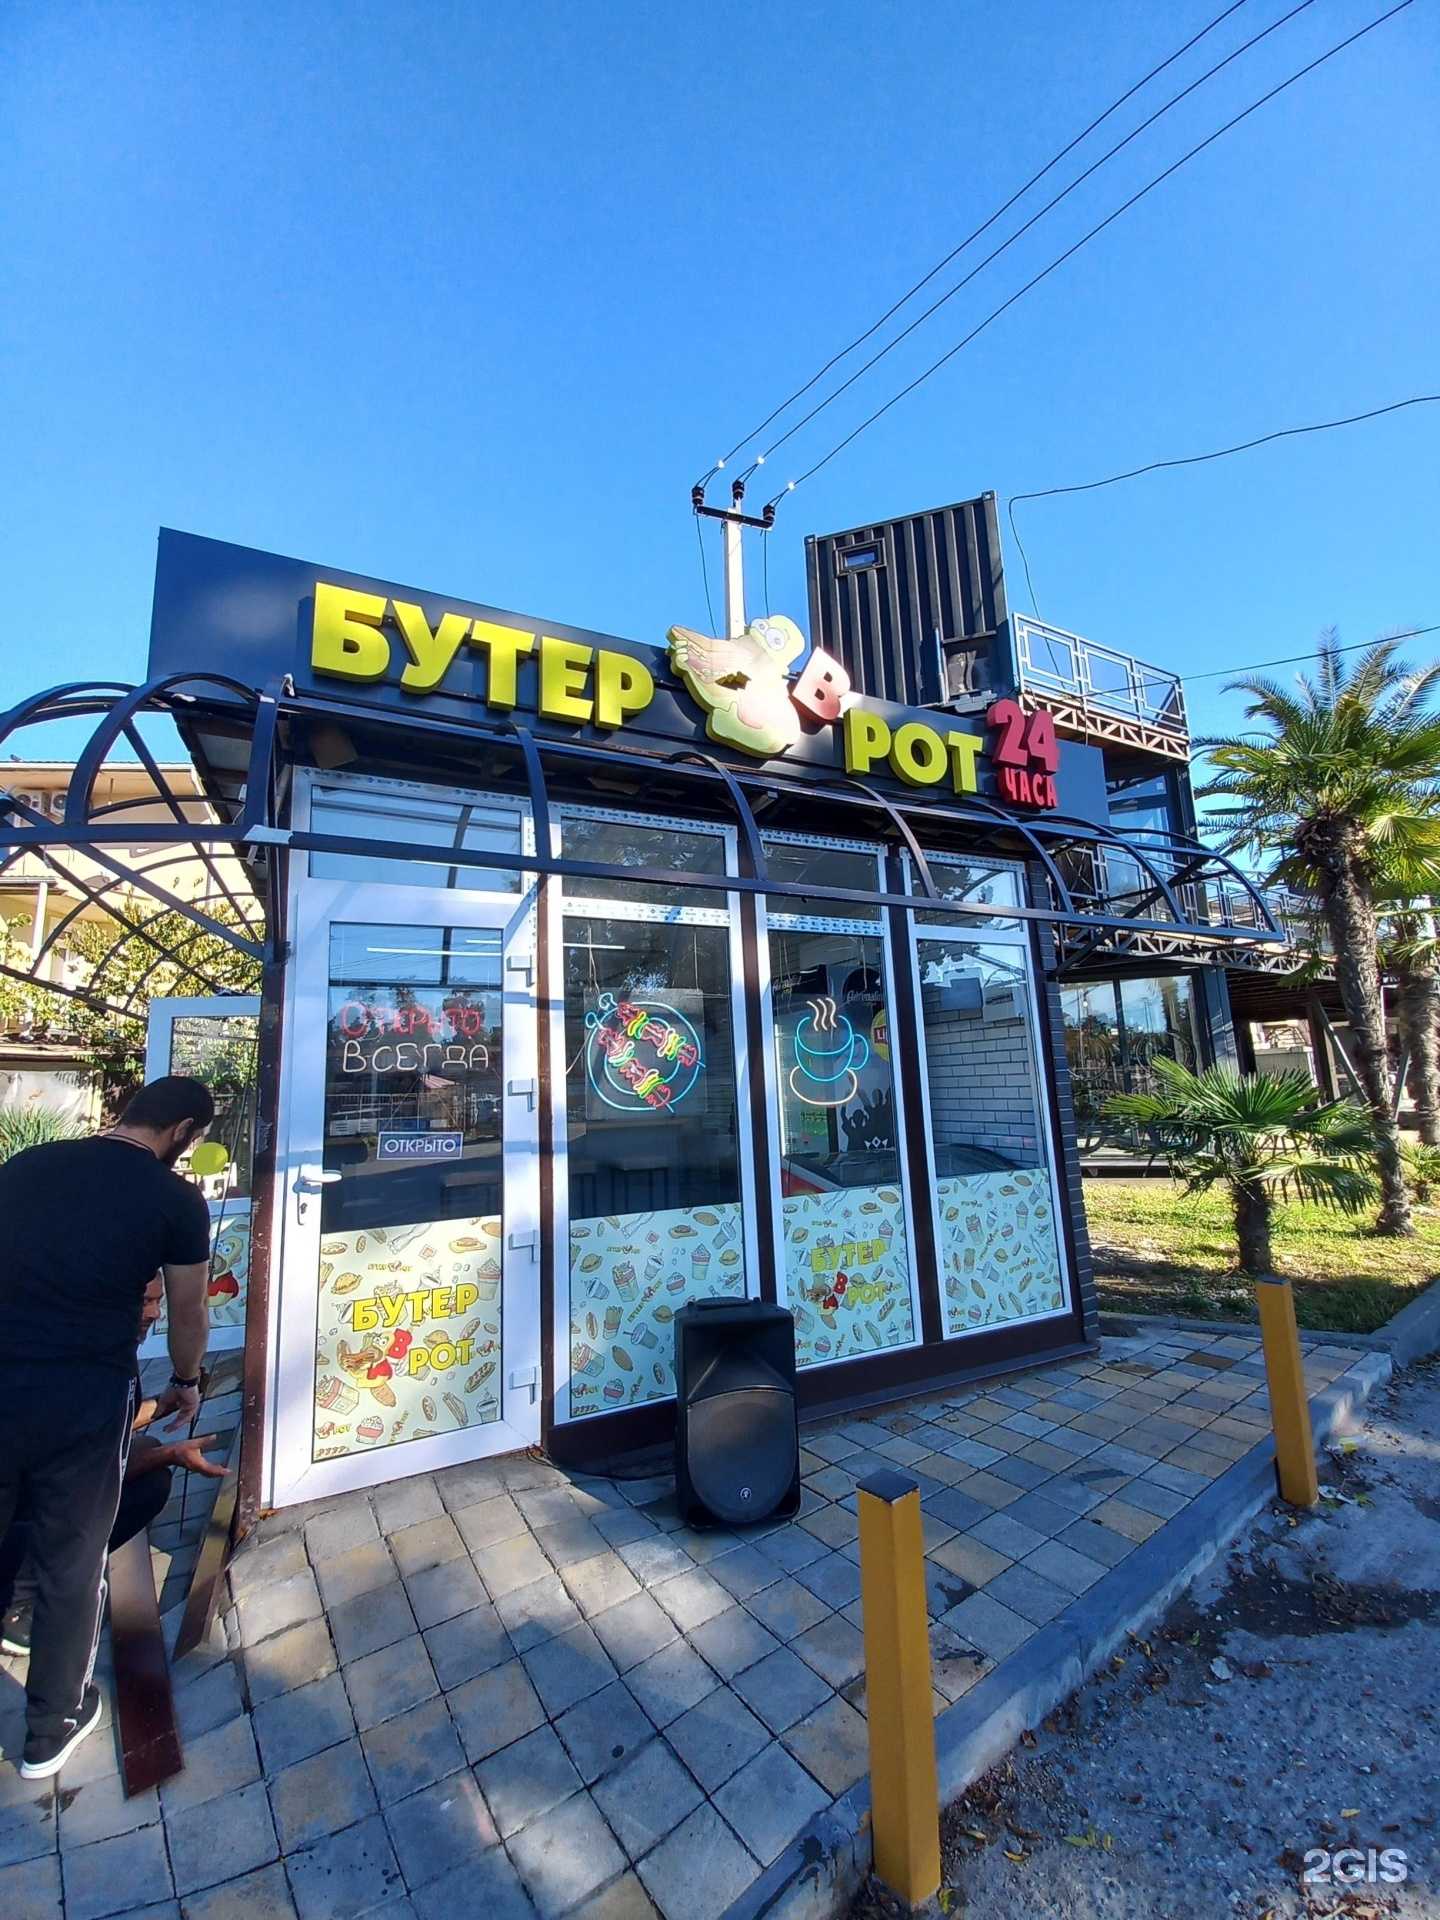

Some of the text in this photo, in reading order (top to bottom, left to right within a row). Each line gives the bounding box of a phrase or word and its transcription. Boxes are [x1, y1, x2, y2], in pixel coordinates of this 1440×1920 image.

[311, 582, 983, 796] БУТЕР В РОТ
[987, 700, 1059, 775] 24
[1000, 768, 1058, 809] ЧАСА
[343, 1040, 488, 1073] ВСЕГДА
[384, 1138, 456, 1153] ОТКРЫТО
[811, 1239, 887, 1273] БУТЕР
[833, 1271, 848, 1295] В
[847, 1281, 887, 1306] РОТ
[352, 1283, 479, 1332] БУТЕР
[386, 1328, 413, 1359] В
[409, 1338, 475, 1376] РОТ
